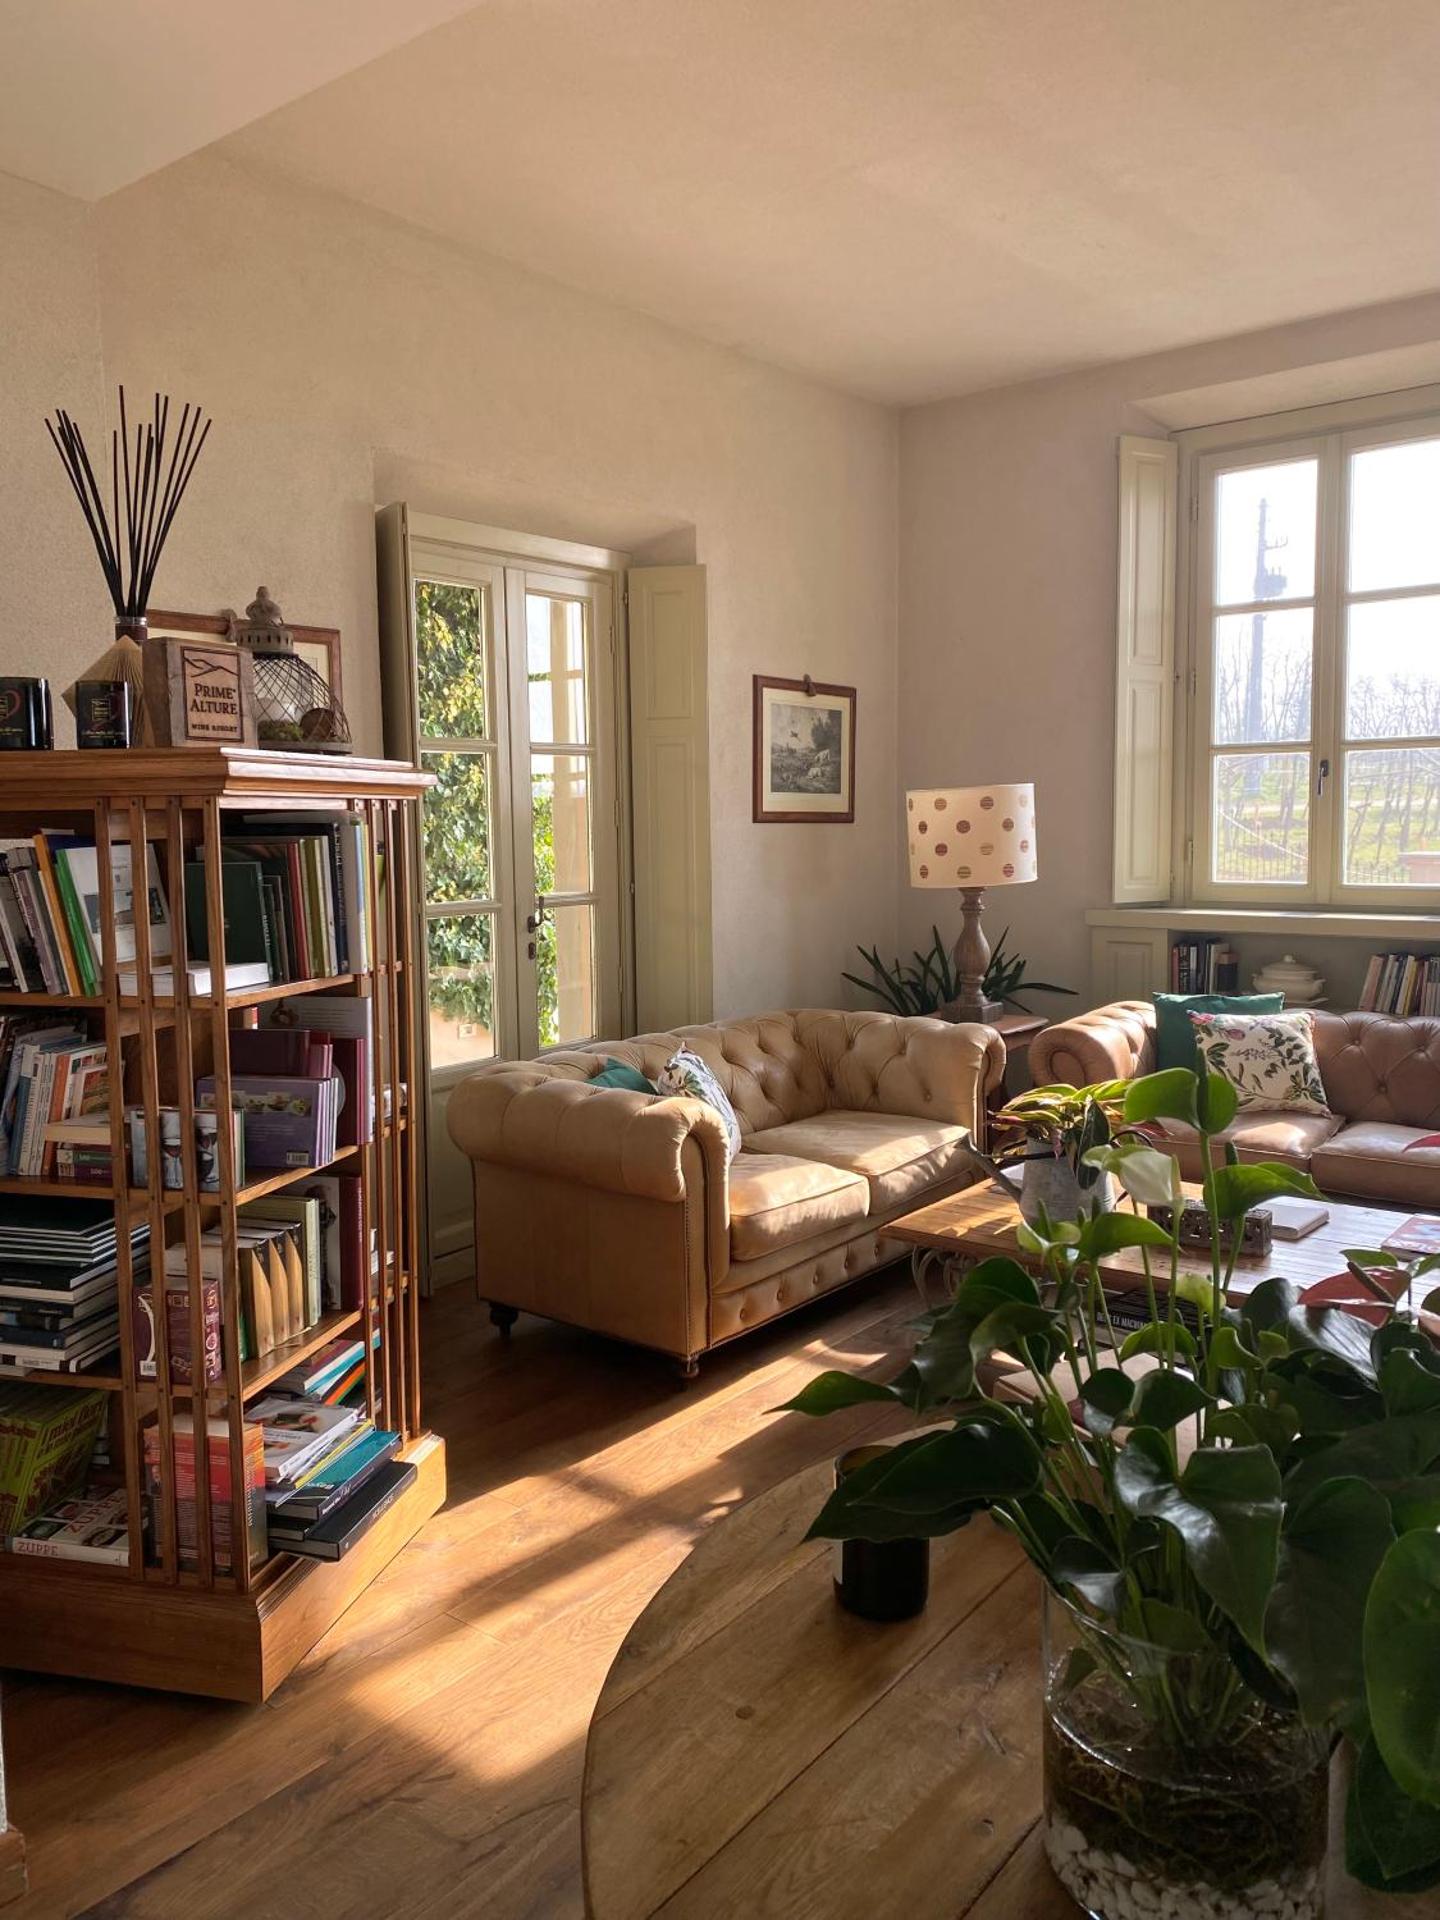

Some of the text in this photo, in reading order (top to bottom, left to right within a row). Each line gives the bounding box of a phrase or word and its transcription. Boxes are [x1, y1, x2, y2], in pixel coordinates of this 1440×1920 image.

[194, 683, 234, 700] PRIME
[190, 699, 238, 715] ALTURE
[17, 1541, 58, 1556] ZUPPE
